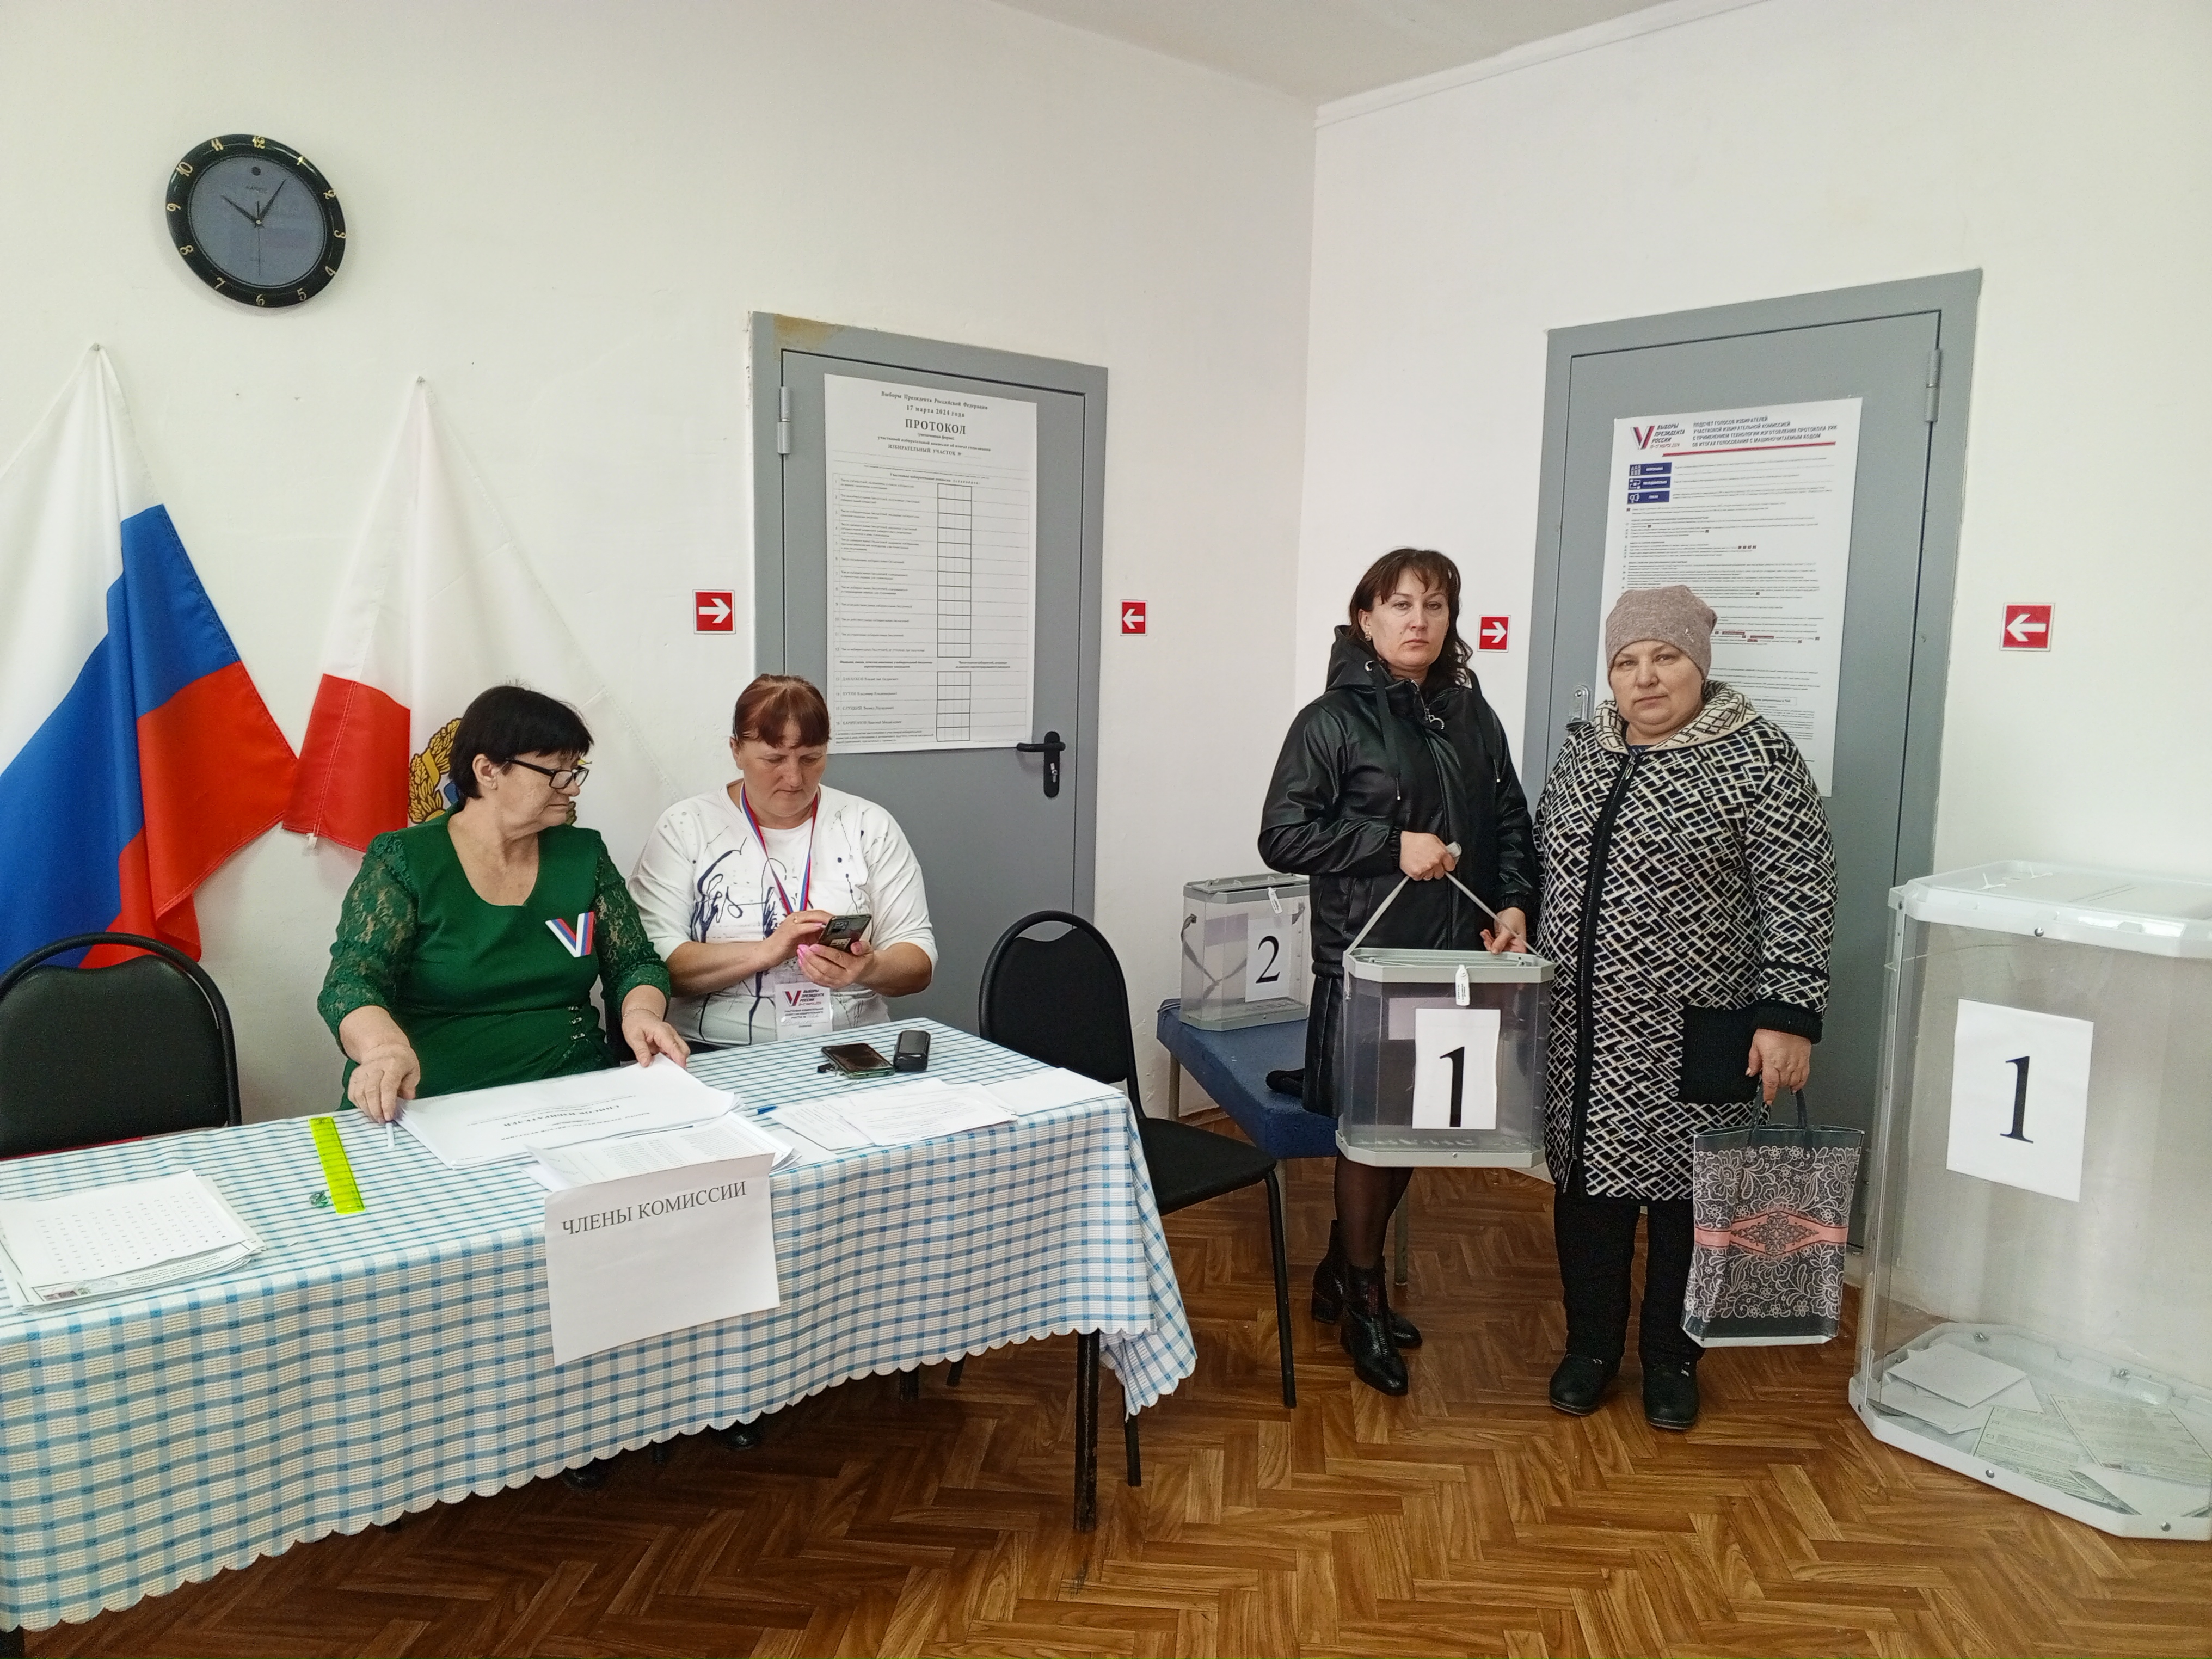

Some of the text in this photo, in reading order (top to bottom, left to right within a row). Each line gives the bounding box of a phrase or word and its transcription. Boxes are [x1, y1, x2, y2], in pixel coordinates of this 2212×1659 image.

[211, 139, 224, 151] 11
[252, 136, 265, 149] 12
[176, 162, 193, 176] 10
[323, 189, 336, 200] 2
[167, 202, 181, 212] 9
[334, 229, 346, 239] 3
[179, 244, 193, 256] 8
[324, 266, 336, 276] 4
[214, 277, 225, 290] 7
[256, 294, 265, 306] 6
[297, 287, 306, 301] 5
[881, 391, 902, 399] Выборы
[905, 419, 966, 435] ПРОТОКОЛ
[888, 444, 931, 453] ИЗБИРАТЕЛЬНЫЙ
[1255, 935, 1281, 984] 2
[1439, 1046, 1465, 1128] 1
[2000, 1055, 2034, 1144] 1
[561, 1181, 747, 1235] ЧЛЕНЫ КОМИССИИ
